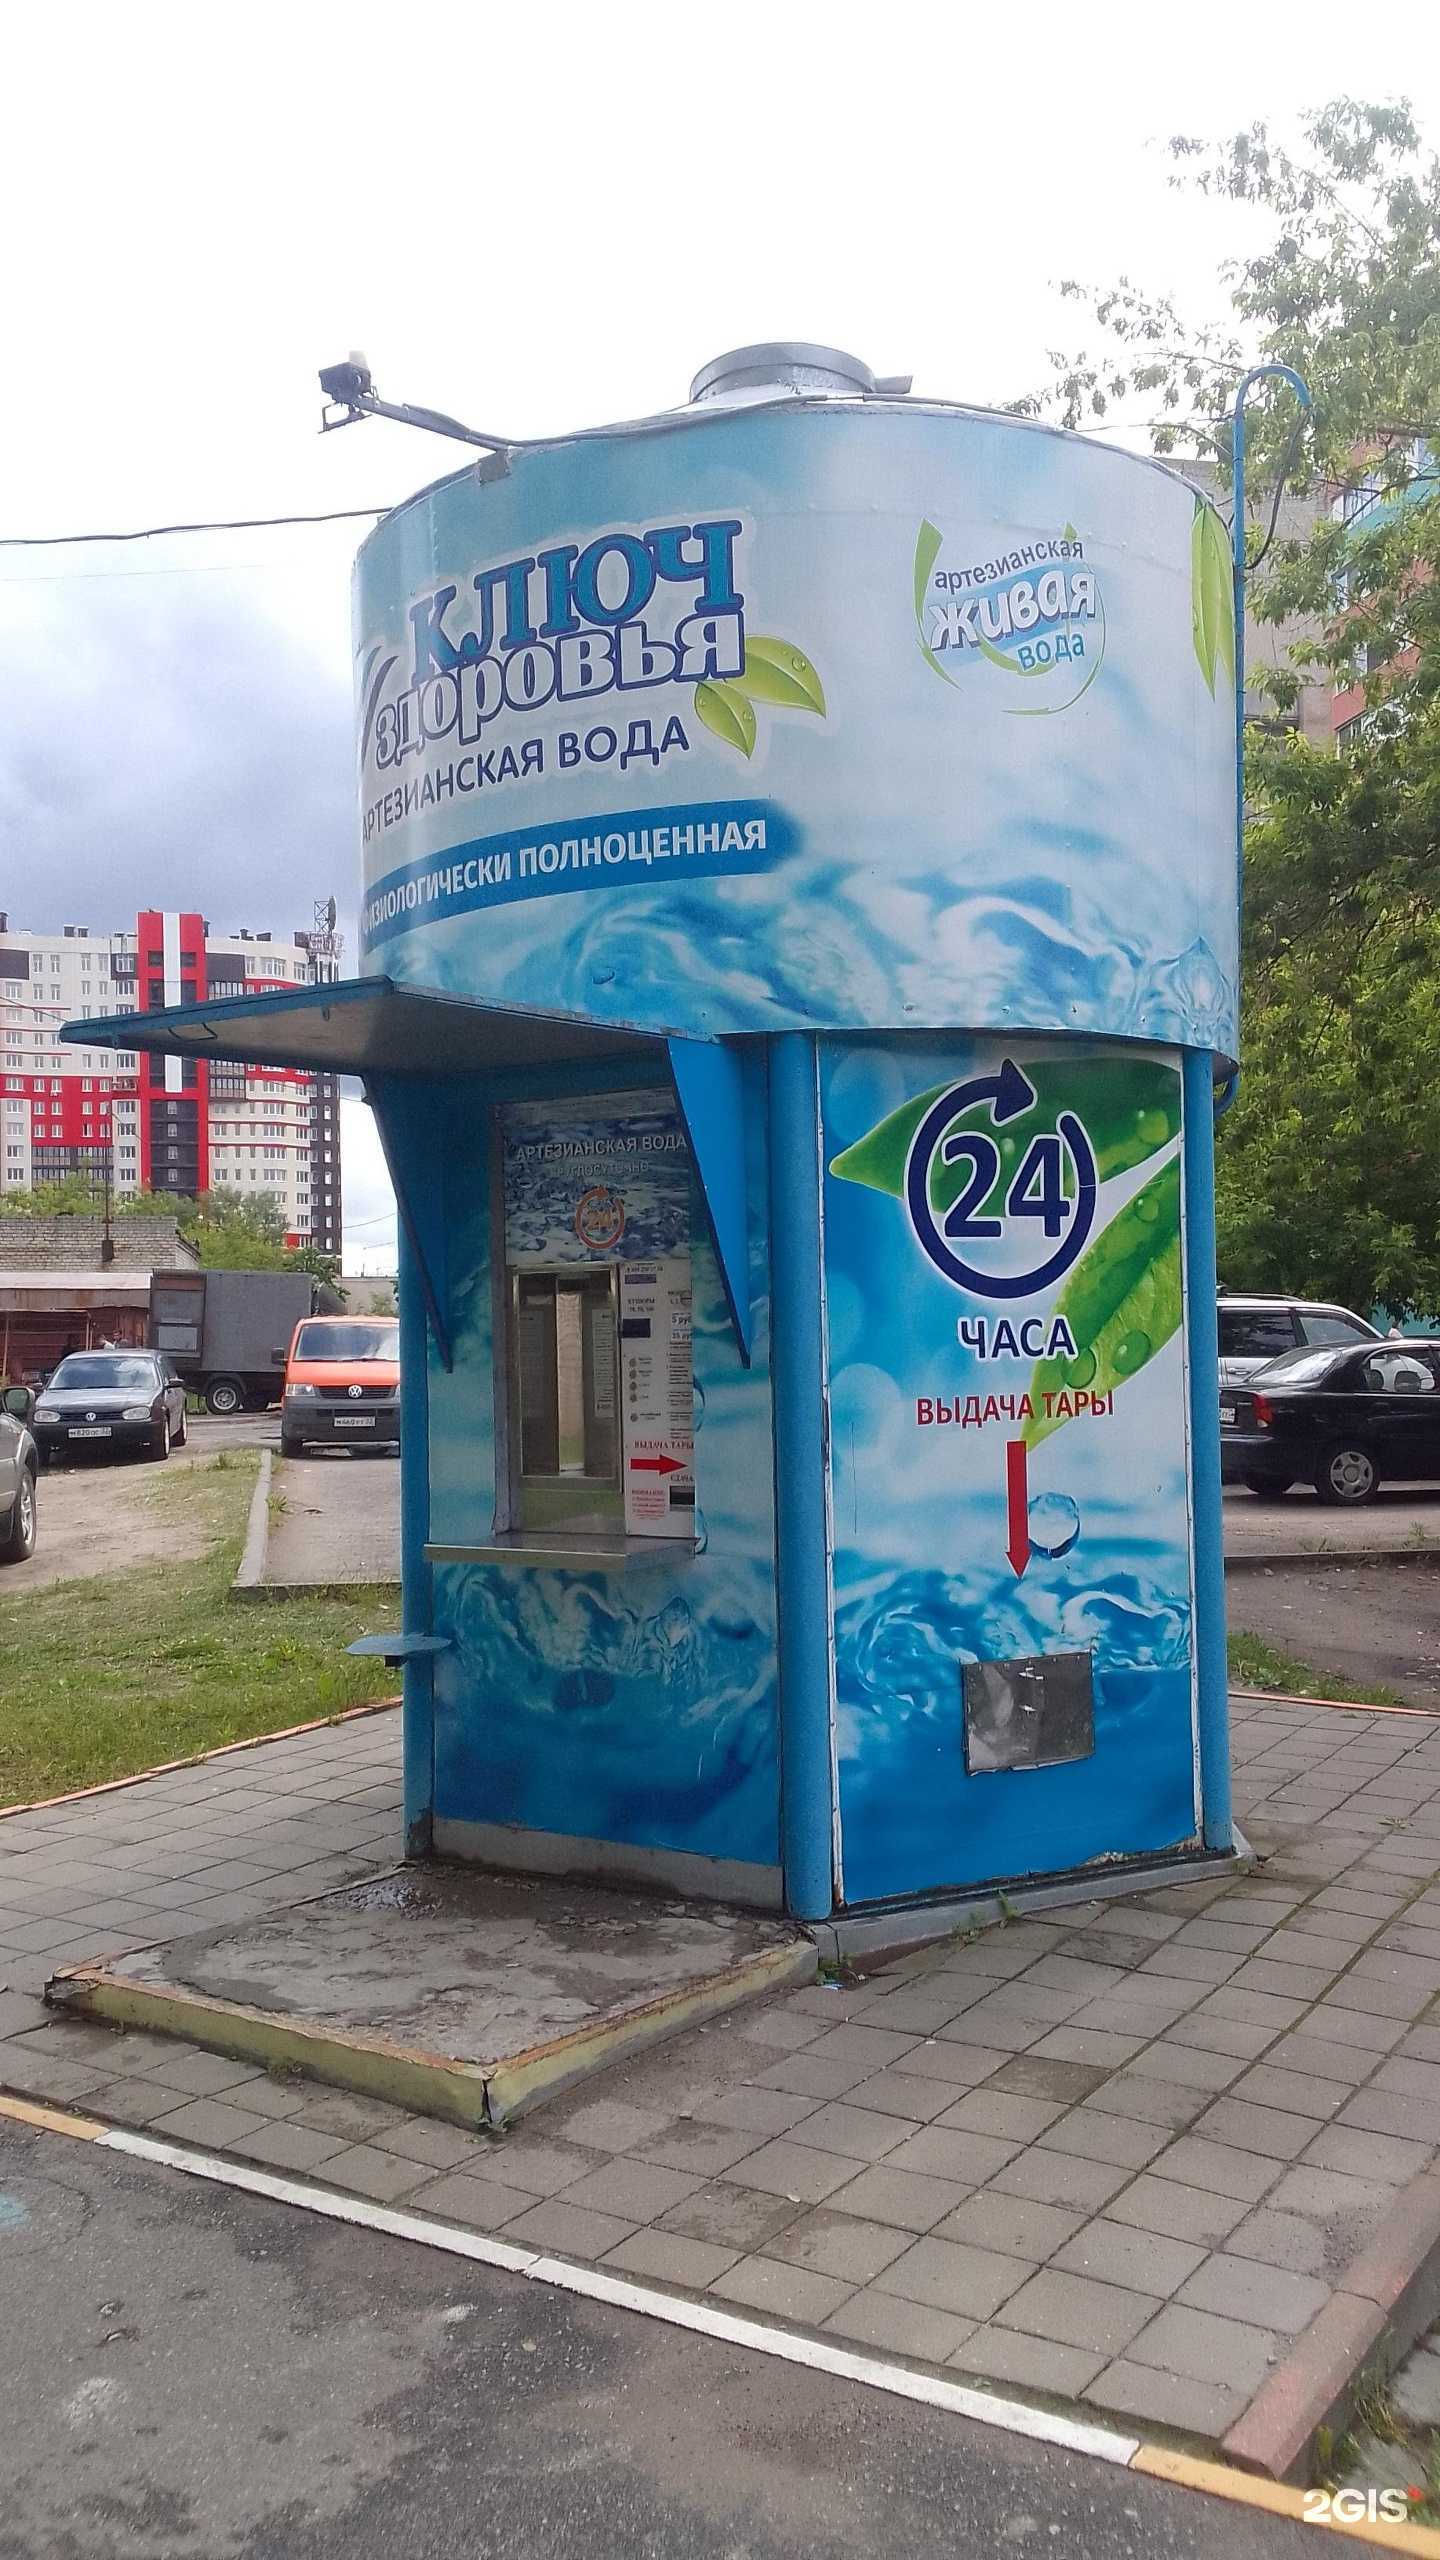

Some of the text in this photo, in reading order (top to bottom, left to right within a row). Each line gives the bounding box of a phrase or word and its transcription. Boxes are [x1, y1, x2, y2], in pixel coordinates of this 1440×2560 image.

[934, 539, 1084, 595] артезианская
[409, 520, 744, 686] КЛЮЧ
[928, 570, 1097, 651] живая
[1017, 631, 1085, 671] вода
[362, 716, 690, 844] АРТЕЗИАНСКАЯ ВОДА
[363, 819, 767, 935] ИЗИОЛОГИЧЕСКИ ПОЛНОЦЕННАЯ
[515, 1133, 687, 1162] АРТЕЗИАНСКАЯ ВОДА
[943, 1134, 1071, 1239] 24
[958, 1317, 1076, 1360] ЧАСА
[916, 1388, 1115, 1428] ВЫДАЧА ТАРЫ
